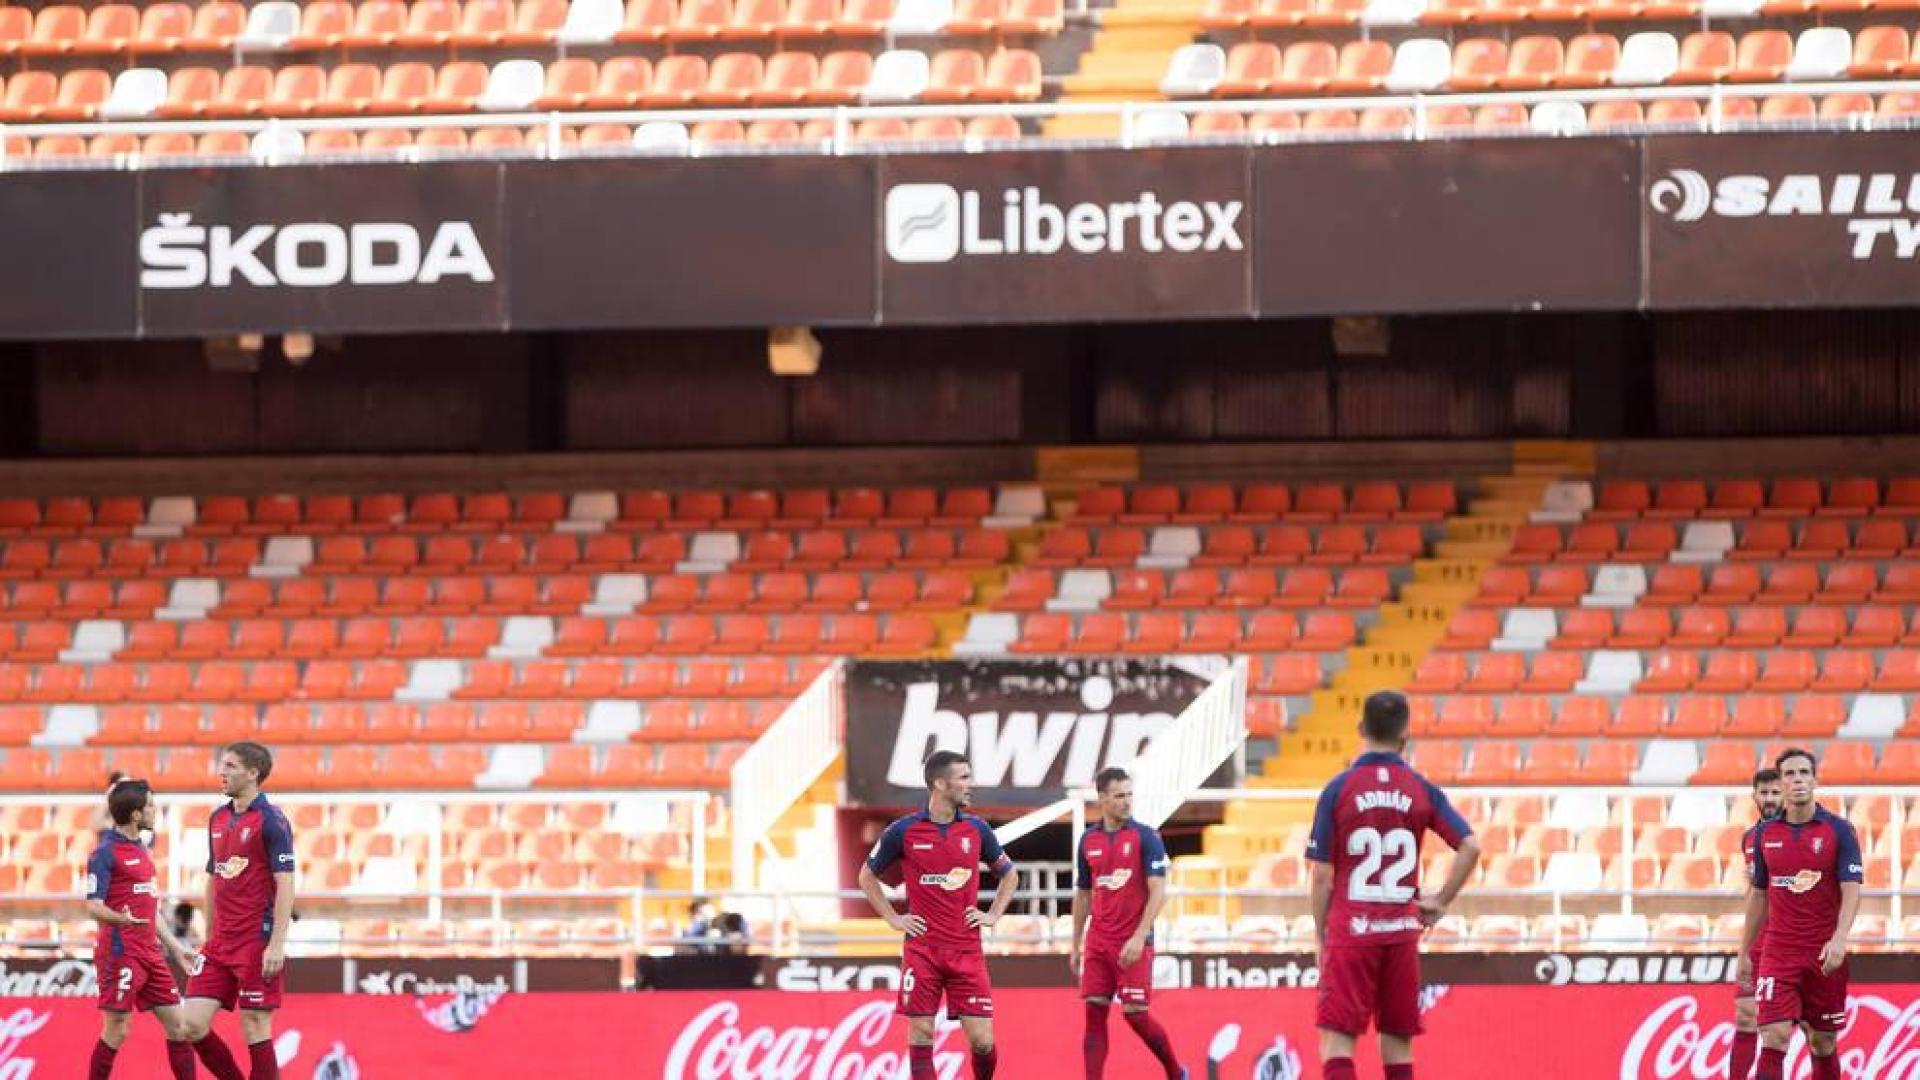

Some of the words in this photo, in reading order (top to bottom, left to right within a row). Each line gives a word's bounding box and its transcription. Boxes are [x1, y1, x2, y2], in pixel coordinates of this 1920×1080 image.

[963, 187, 1244, 253] Libertex
[140, 212, 495, 288] ŠKODA
[1347, 826, 1418, 904] 22
[118, 966, 133, 990] 2
[902, 967, 915, 992] 6
[1181, 957, 1320, 988] Liberte
